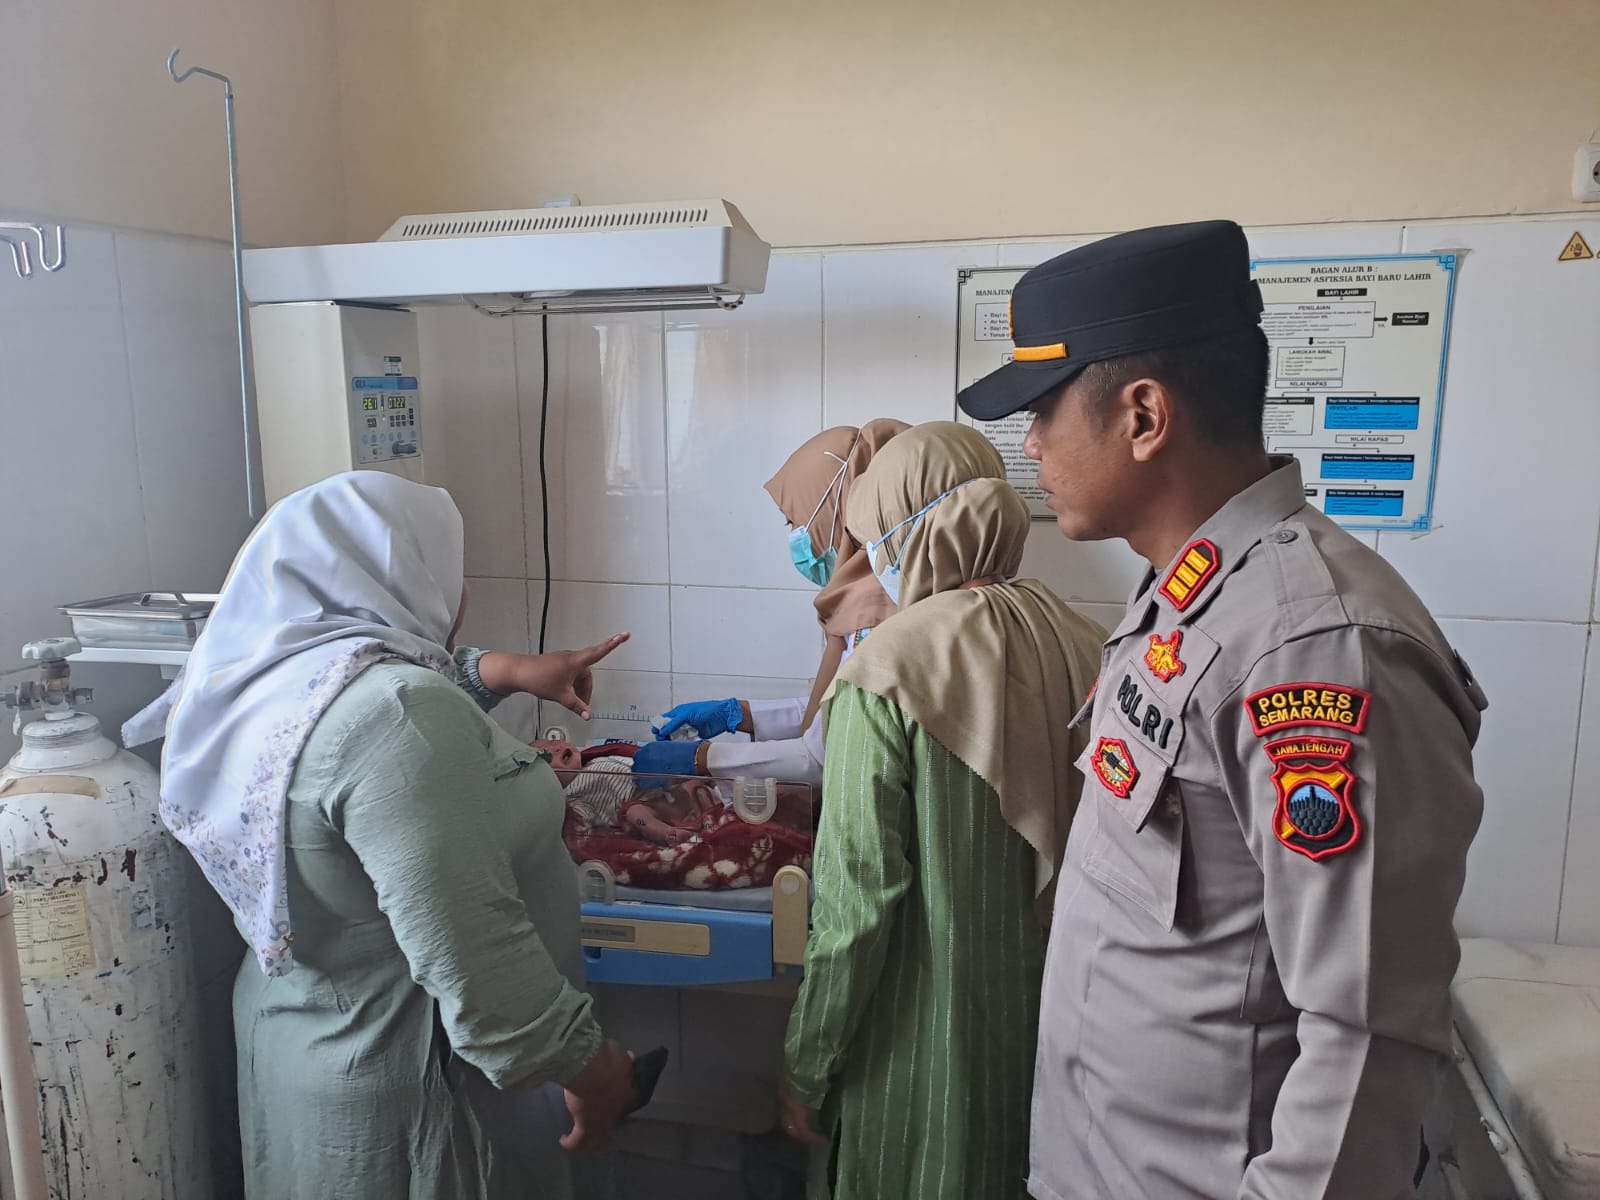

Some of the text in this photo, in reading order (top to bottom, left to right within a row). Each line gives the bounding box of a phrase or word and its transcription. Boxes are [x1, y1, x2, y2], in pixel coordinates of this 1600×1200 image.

[1117, 674, 1174, 750] POLRI
[1258, 689, 1352, 713] POLRES
[1259, 706, 1354, 727] SEMARANG
[1275, 742, 1344, 756] JAWA TENGAH
